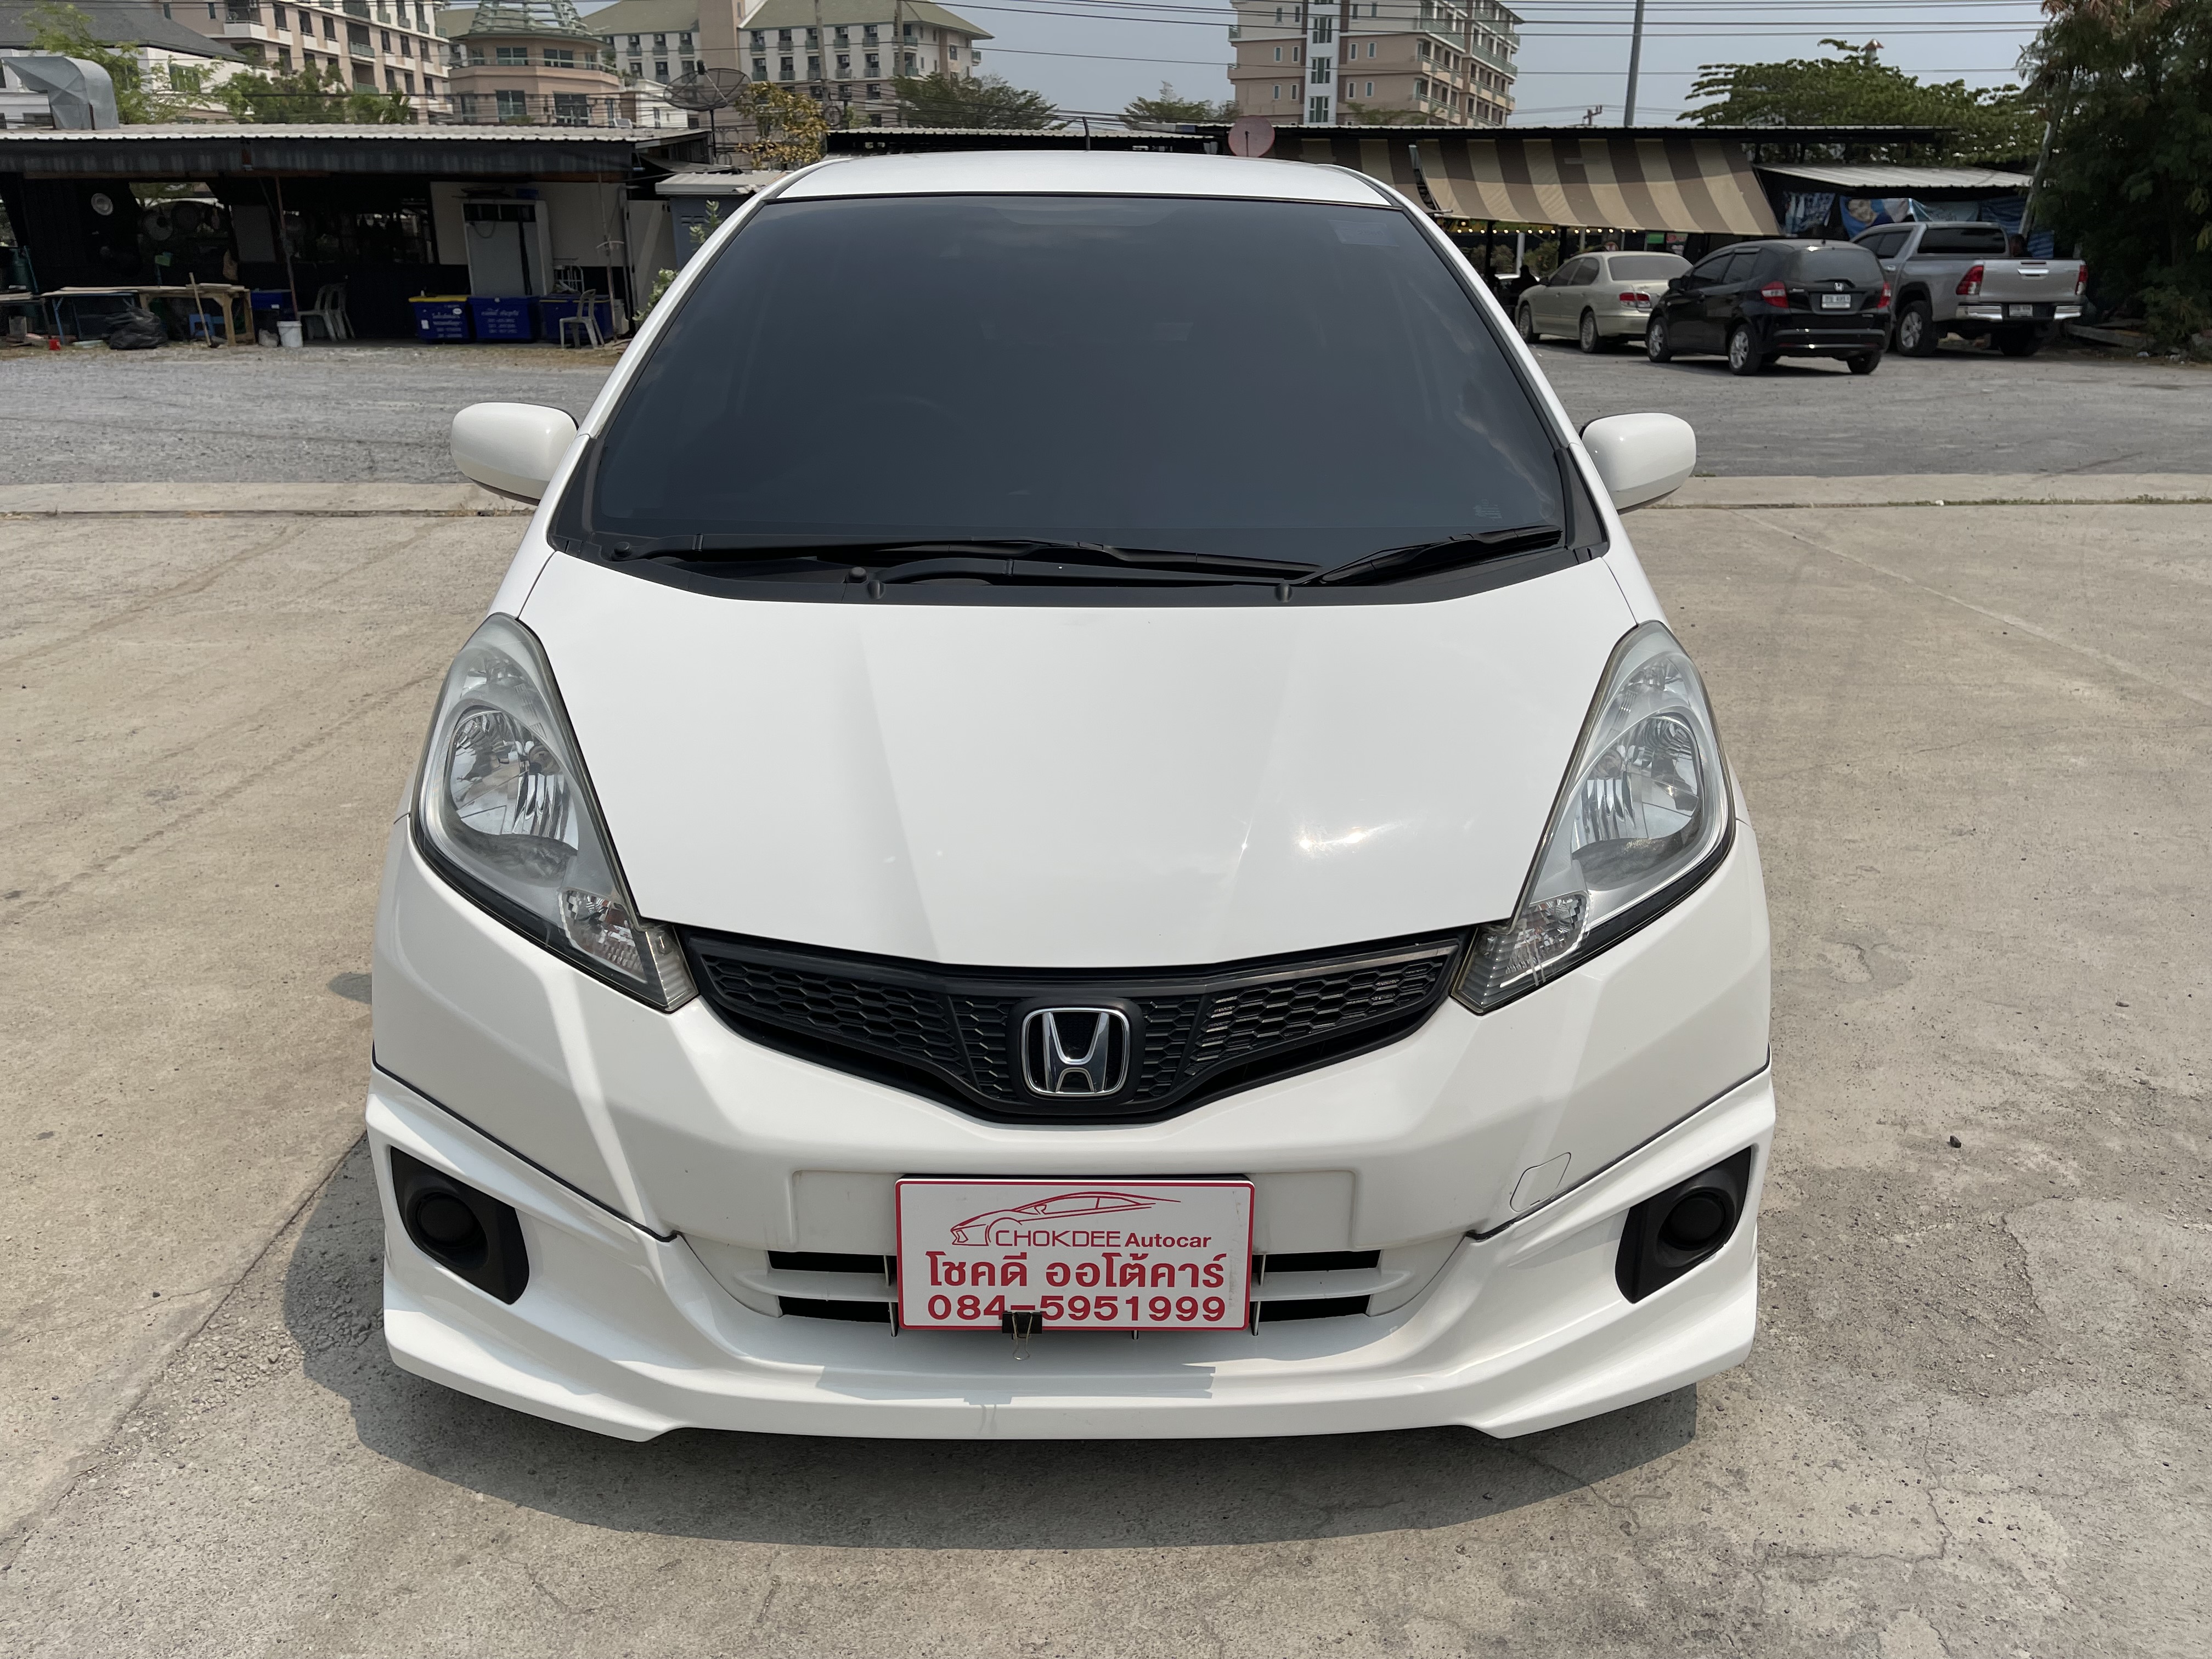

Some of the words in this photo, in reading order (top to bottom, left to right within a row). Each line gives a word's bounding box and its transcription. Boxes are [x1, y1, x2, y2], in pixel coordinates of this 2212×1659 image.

[995, 1229, 1121, 1247] CHOKDEE
[1125, 1232, 1211, 1248] Autocar
[926, 1251, 1028, 1286] โชคดี
[1046, 1252, 1227, 1288] ออโต้คาร์
